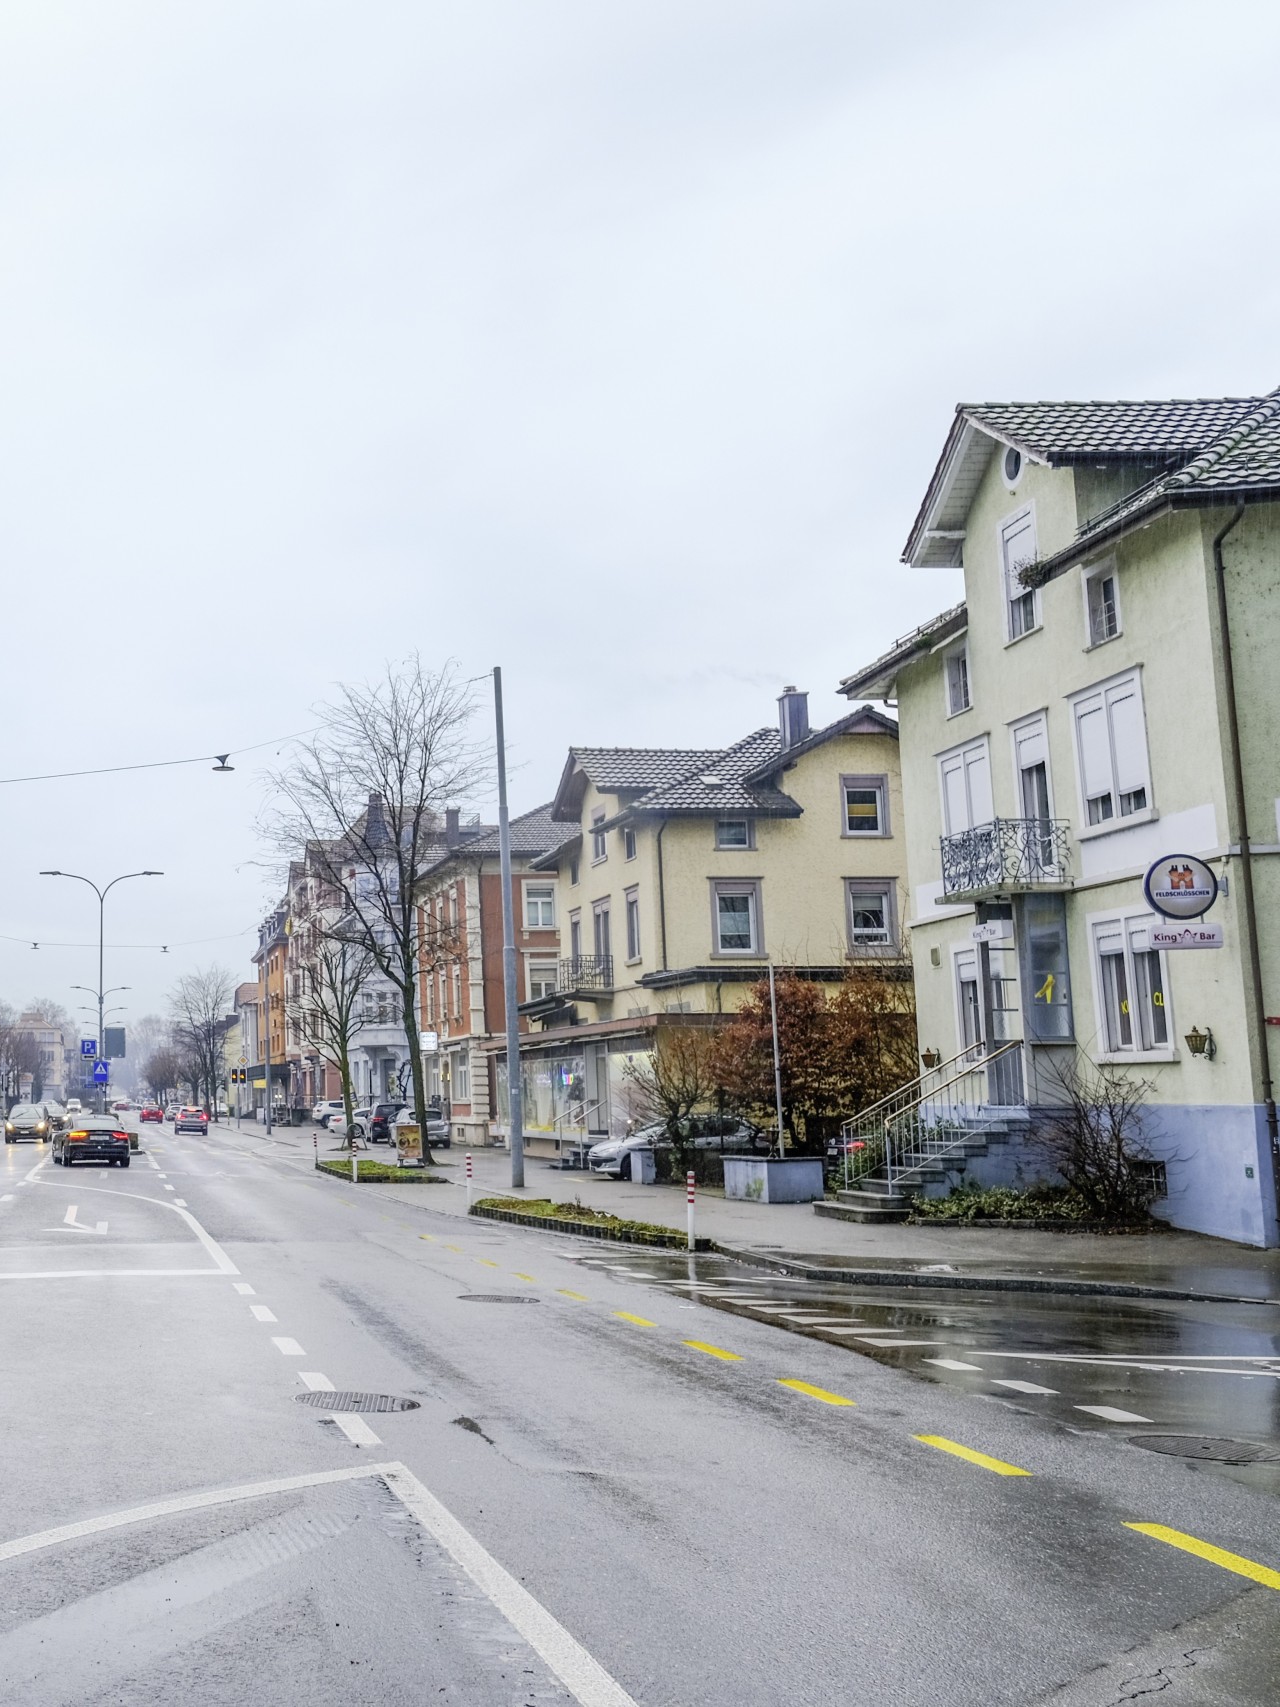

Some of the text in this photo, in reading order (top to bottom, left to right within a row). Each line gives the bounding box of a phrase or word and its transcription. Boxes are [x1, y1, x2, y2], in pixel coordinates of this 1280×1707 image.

[1155, 889, 1210, 898] FELDSCHLÖSSCHEN
[1153, 932, 1216, 943] King Bar
[84, 1042, 91, 1052] P
